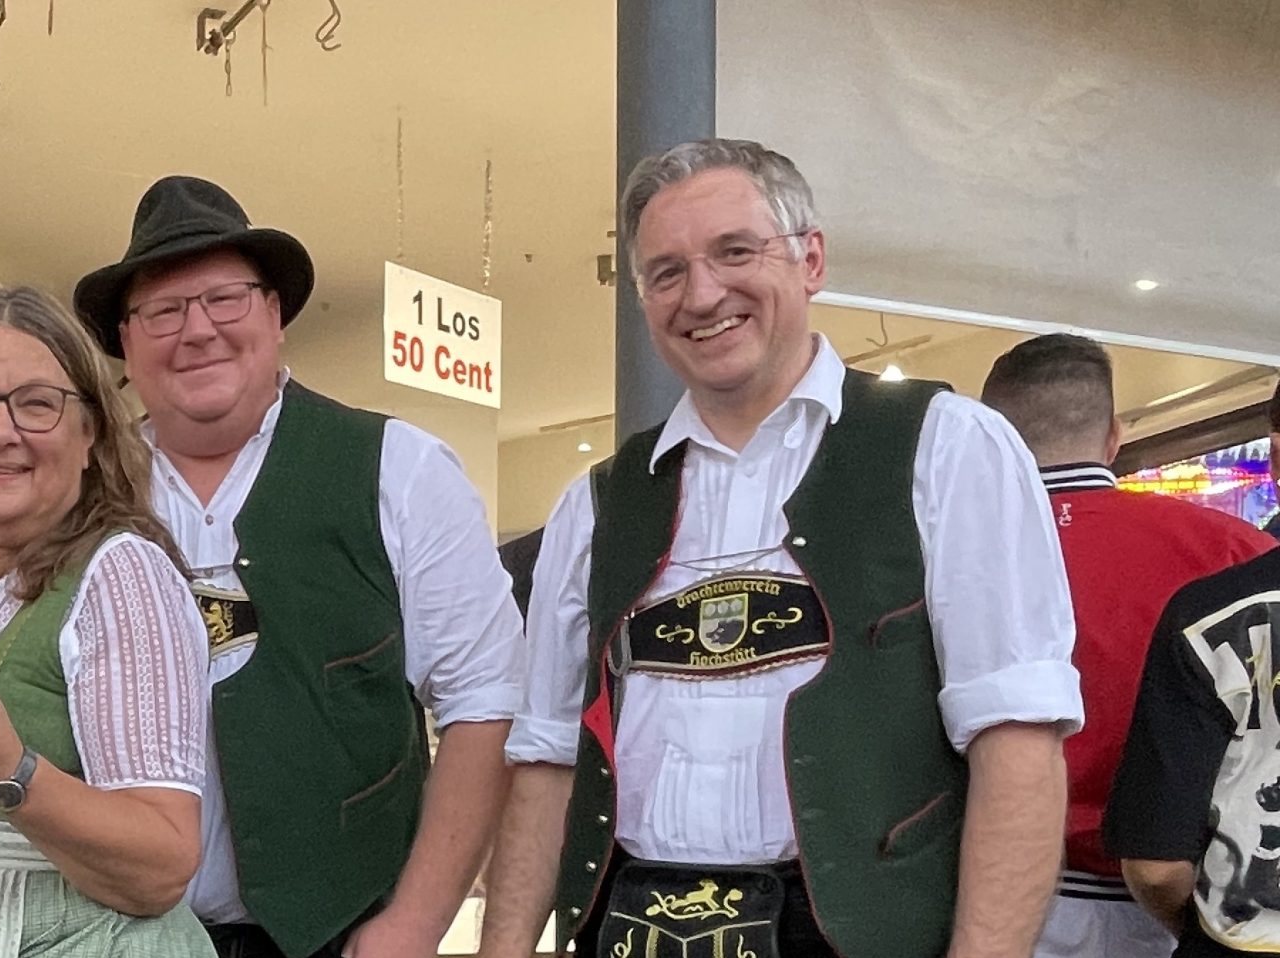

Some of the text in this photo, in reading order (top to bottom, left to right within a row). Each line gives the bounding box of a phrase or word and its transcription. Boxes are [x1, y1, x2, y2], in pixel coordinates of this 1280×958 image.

[412, 289, 480, 341] 1 Los
[392, 330, 493, 393] 50 Cent
[676, 579, 781, 609] Trachtenverein
